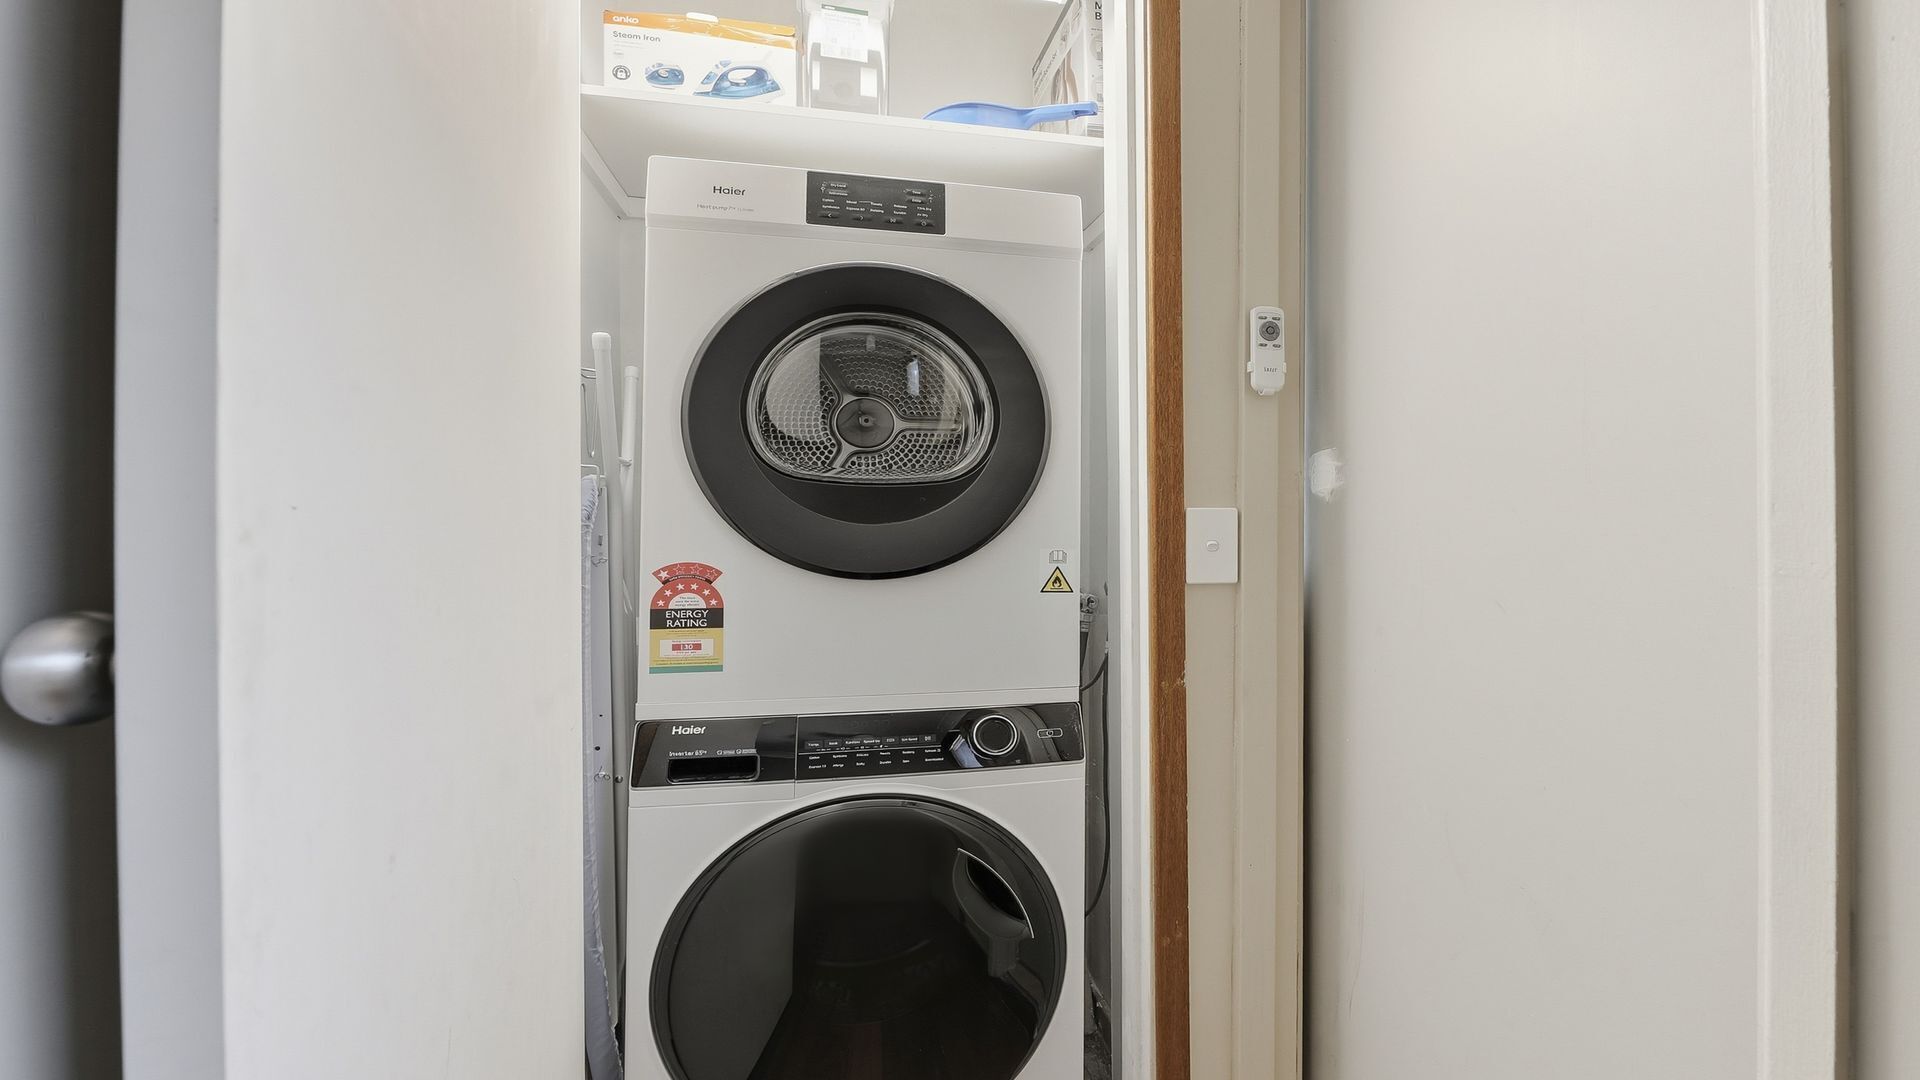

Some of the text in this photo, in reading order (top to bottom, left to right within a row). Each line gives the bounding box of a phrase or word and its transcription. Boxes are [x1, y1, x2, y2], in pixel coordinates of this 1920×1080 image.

[612, 16, 639, 24] anko
[613, 30, 661, 42] Steam Iron
[713, 185, 746, 196] Haier
[666, 609, 709, 619] ENERGY
[666, 619, 708, 628] RATING
[671, 725, 707, 735] Haier
